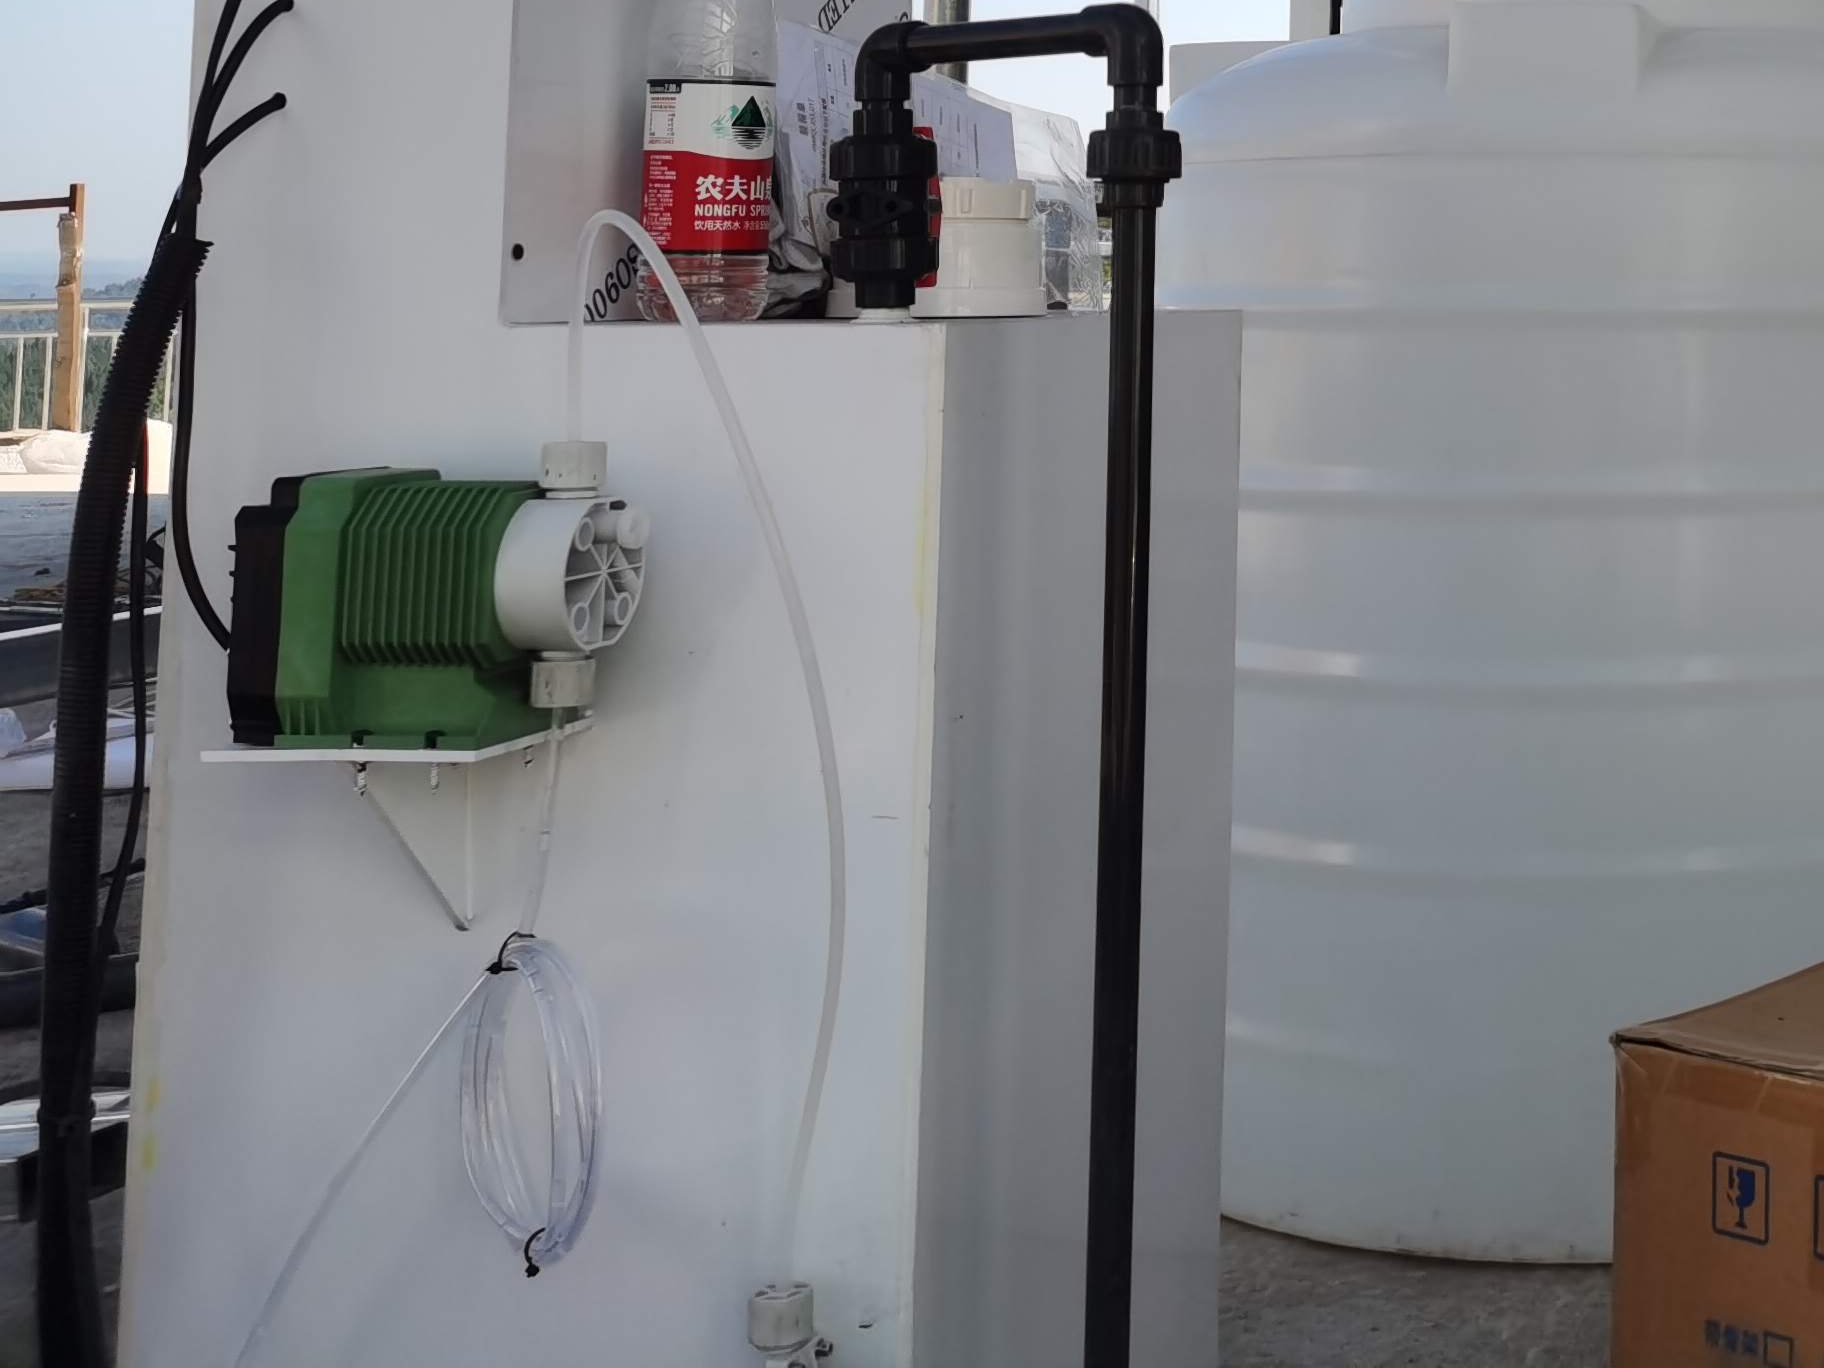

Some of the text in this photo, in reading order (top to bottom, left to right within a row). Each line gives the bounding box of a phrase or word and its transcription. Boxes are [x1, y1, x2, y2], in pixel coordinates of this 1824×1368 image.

[694, 203, 746, 217] NONGFU
[694, 220, 741, 231] 饮用天然水
